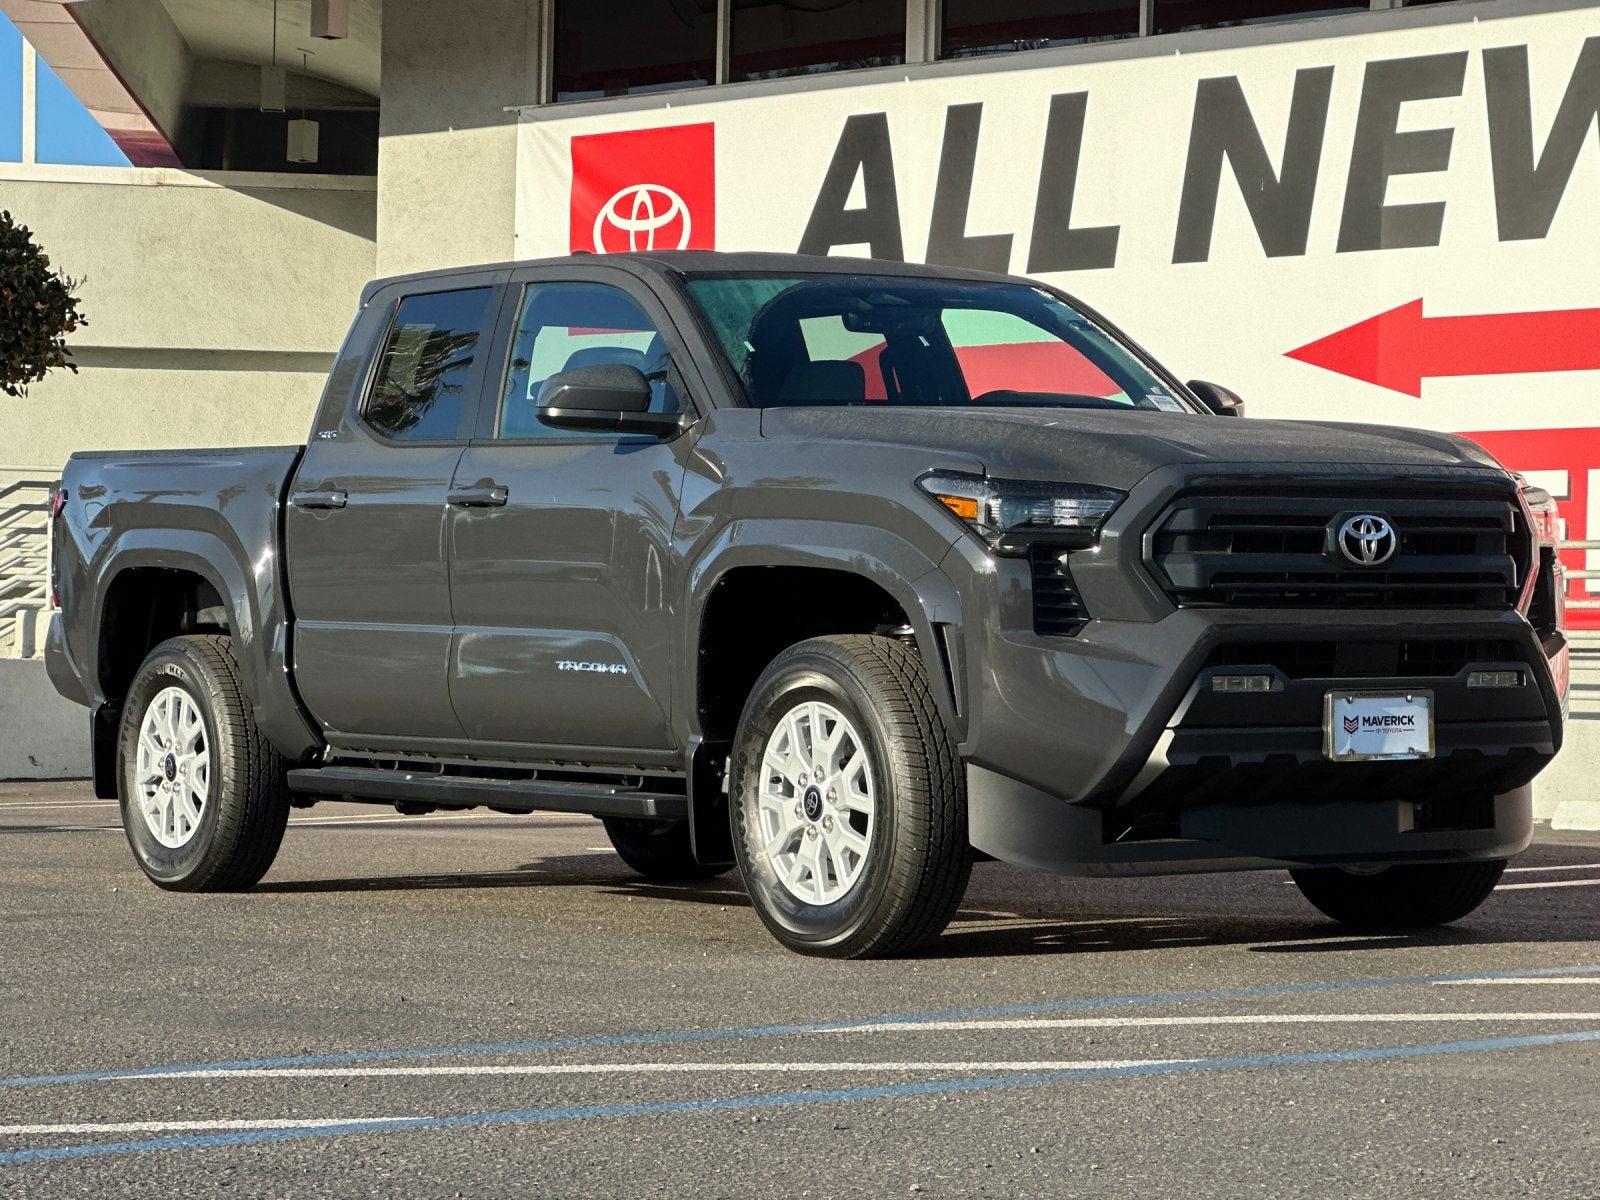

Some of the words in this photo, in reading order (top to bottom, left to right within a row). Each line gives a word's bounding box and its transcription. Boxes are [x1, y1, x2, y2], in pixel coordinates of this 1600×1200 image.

[798, 91, 1121, 274] ALL
[555, 660, 628, 674] TACOMA
[1362, 715, 1415, 727] MAVERICK
